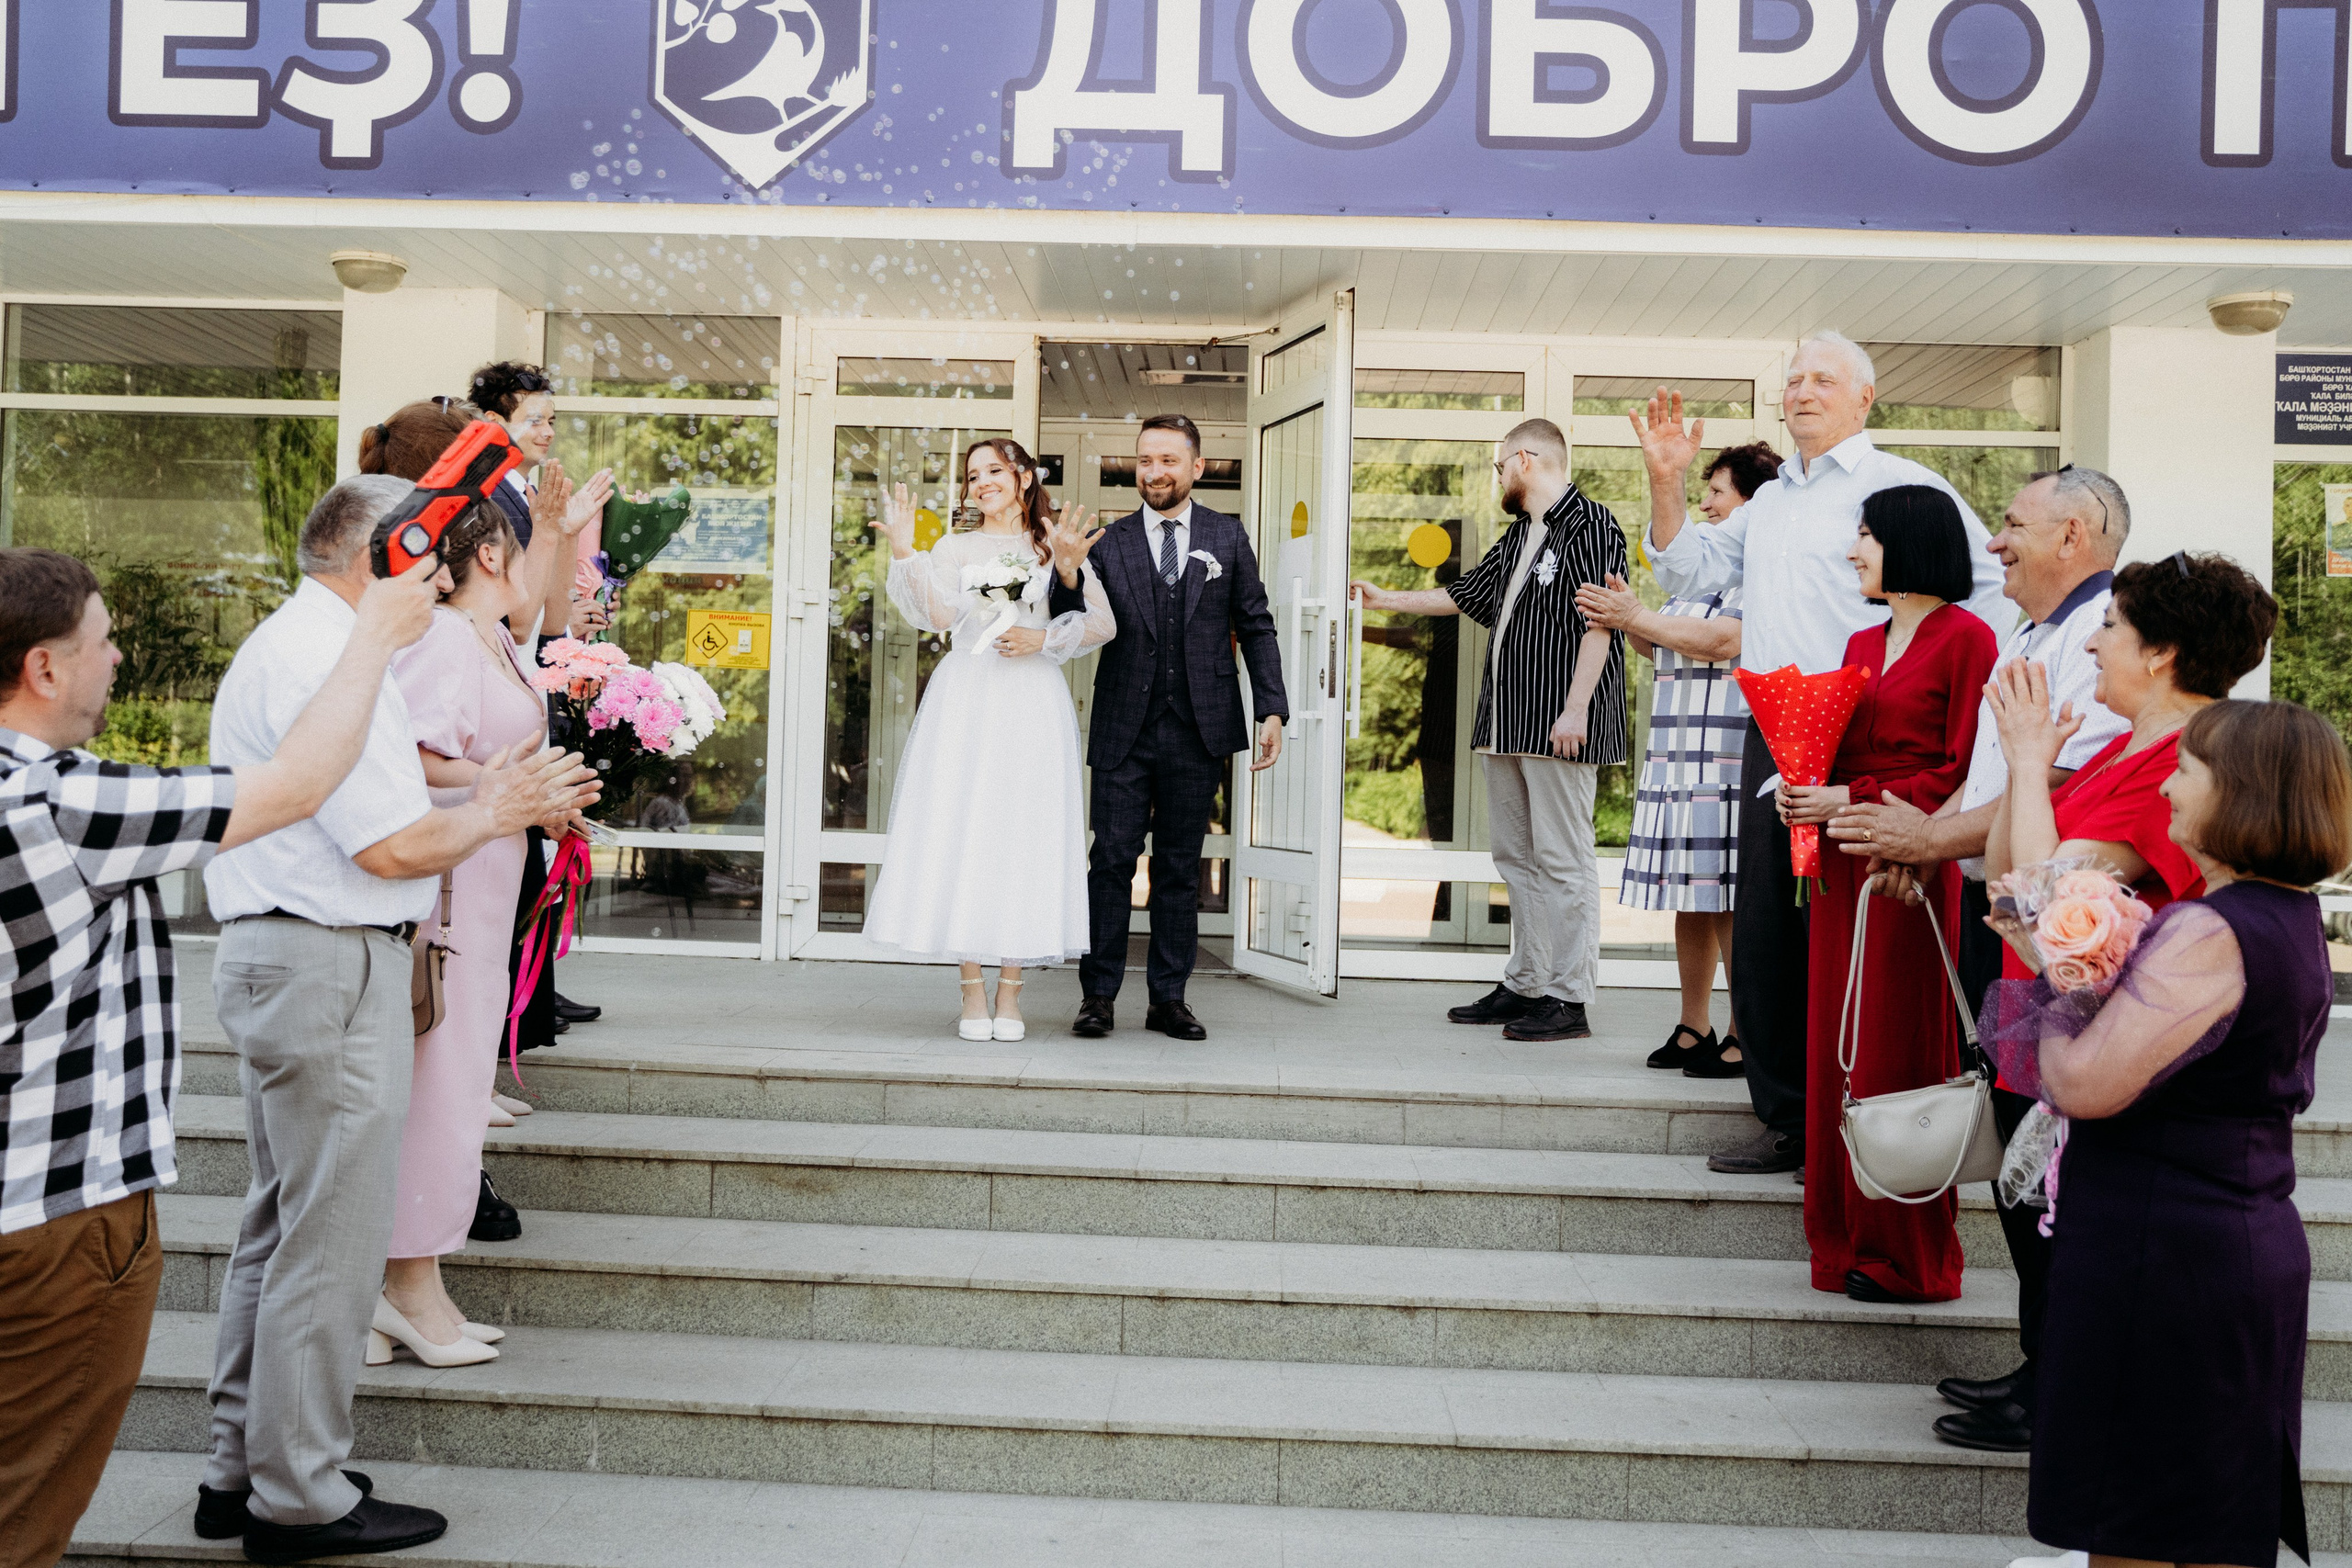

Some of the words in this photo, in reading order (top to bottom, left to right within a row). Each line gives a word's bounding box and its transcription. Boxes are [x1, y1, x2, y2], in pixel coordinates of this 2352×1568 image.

[1008, 0, 2097, 176] ДОБРО
[2278, 374, 2301, 382] БӨРӨ
[2301, 374, 2334, 383] РАЙОНЫ
[2335, 375, 2352, 383] МУН
[2322, 383, 2344, 391] БӨРӨ
[2275, 400, 2307, 412] ҠАЛА
[708, 614, 752, 622] ВНИМАНИЕ!
